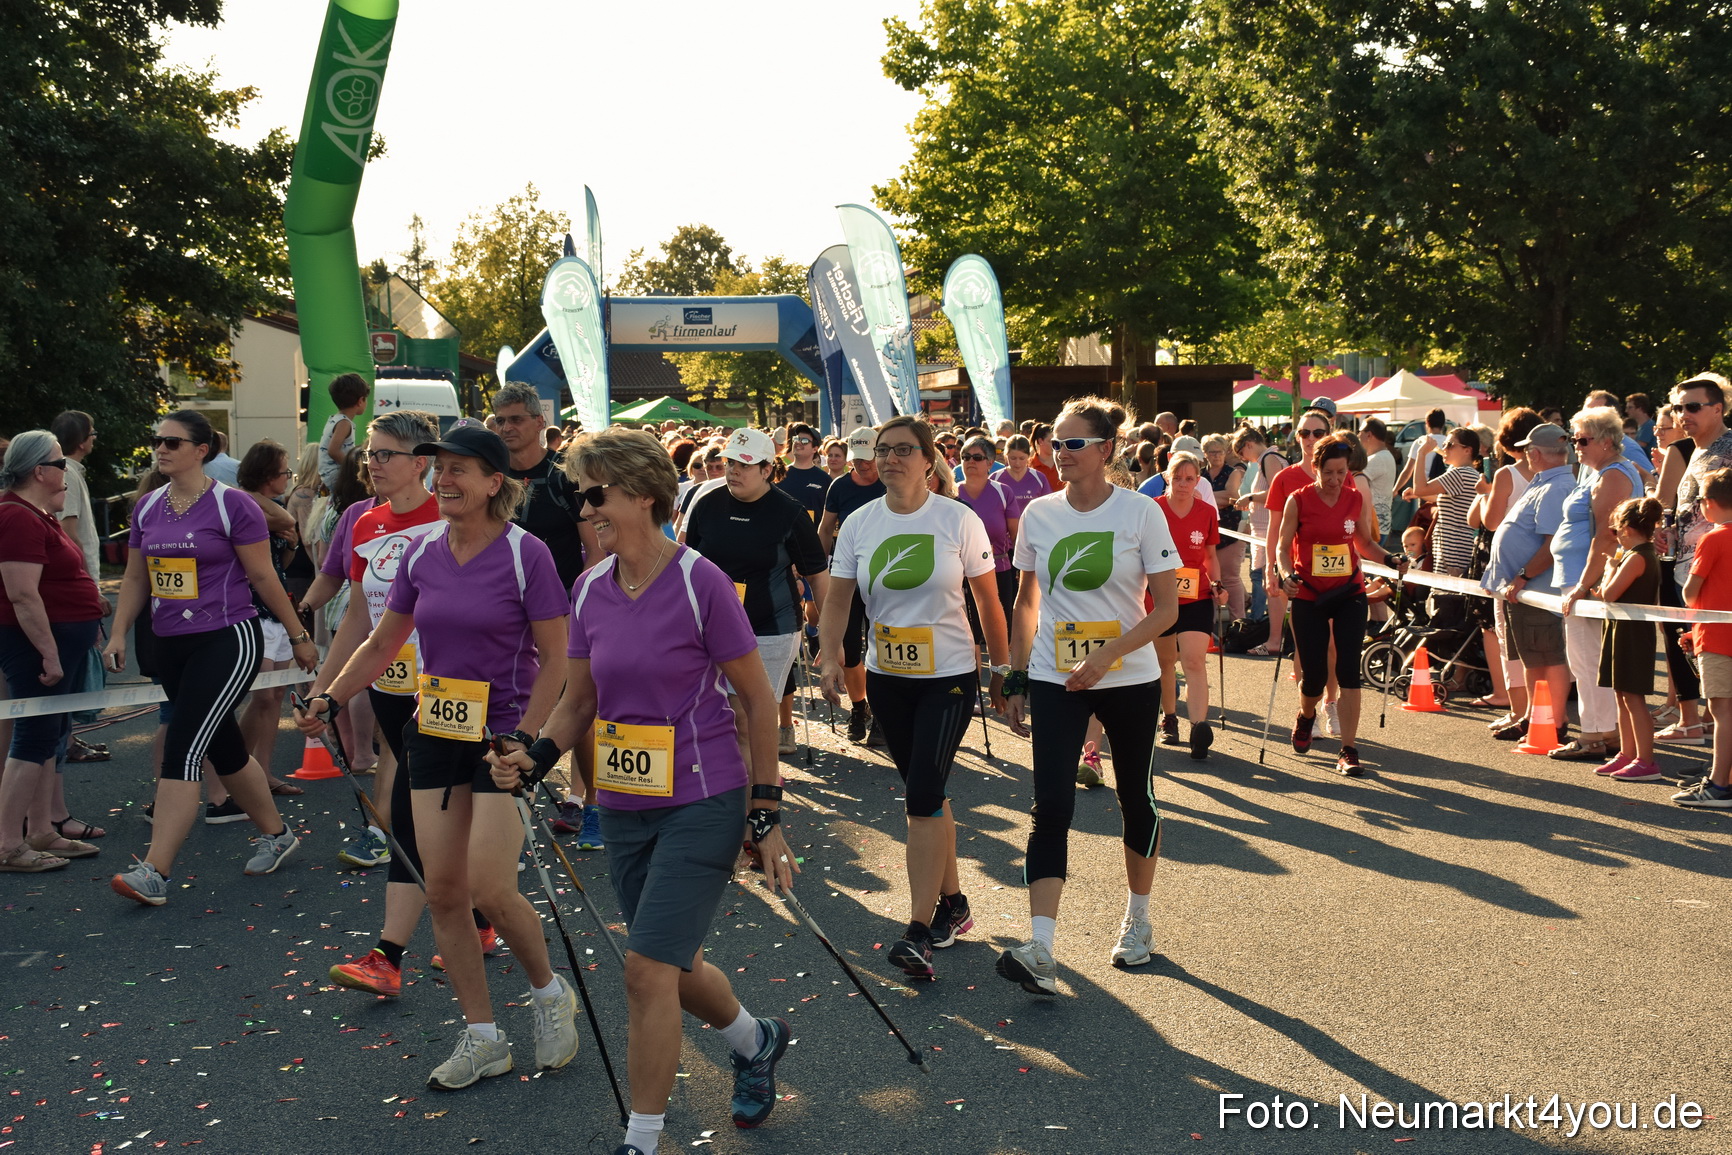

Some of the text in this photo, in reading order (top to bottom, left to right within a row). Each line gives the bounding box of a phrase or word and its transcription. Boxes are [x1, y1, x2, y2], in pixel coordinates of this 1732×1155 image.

[320, 17, 394, 169] AOK
[673, 325, 738, 337] firmenlauf
[1321, 555, 1345, 568] 374
[156, 572, 184, 587] 678
[1175, 577, 1190, 590] 73
[885, 642, 918, 662] 118
[380, 661, 408, 680] 63
[430, 698, 468, 723] 468
[426, 719, 457, 729] Liebel-Fuchs
[457, 723, 474, 731] Birgit
[606, 747, 651, 776] 460
[606, 771, 653, 784] Sammüller Resi
